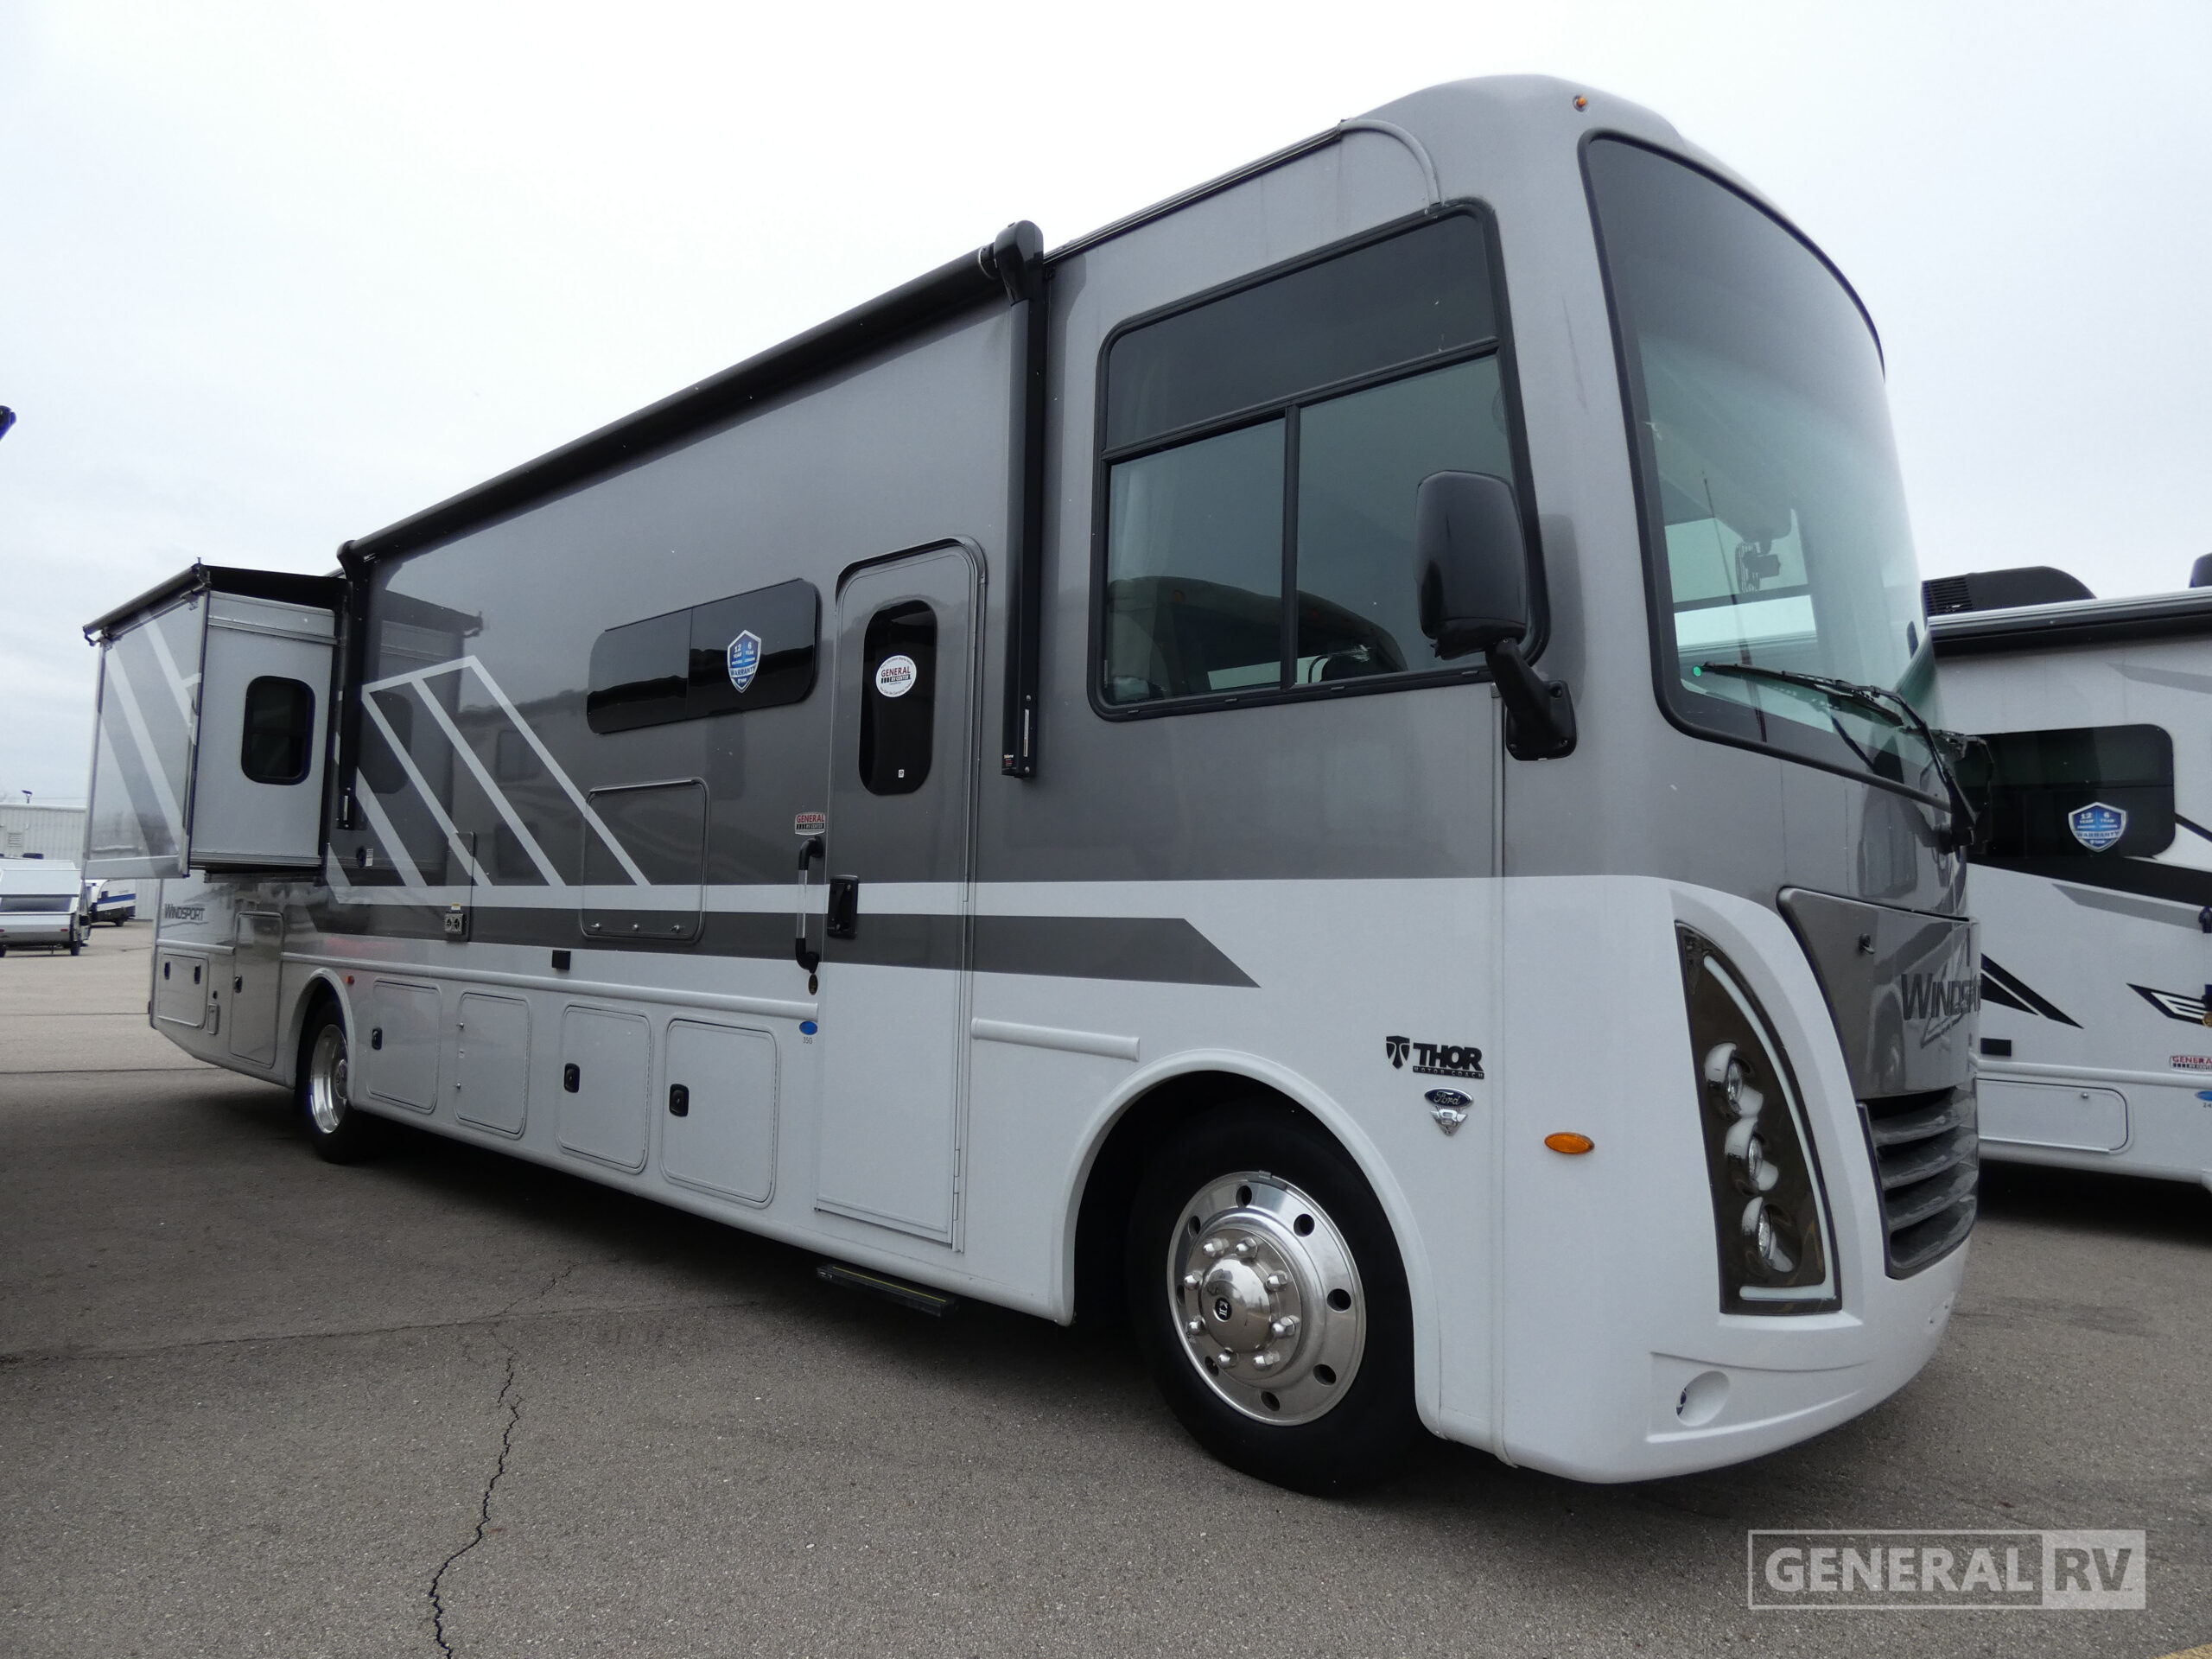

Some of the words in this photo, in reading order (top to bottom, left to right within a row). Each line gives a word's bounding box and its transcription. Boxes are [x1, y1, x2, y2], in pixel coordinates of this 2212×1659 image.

[734, 644, 741, 652] 12
[880, 665, 911, 677] GENERAL
[796, 814, 824, 823] GENERAL
[164, 903, 206, 921] WINDSPORT
[1413, 1042, 1484, 1072] THOR
[1433, 1090, 1461, 1105] Ford
